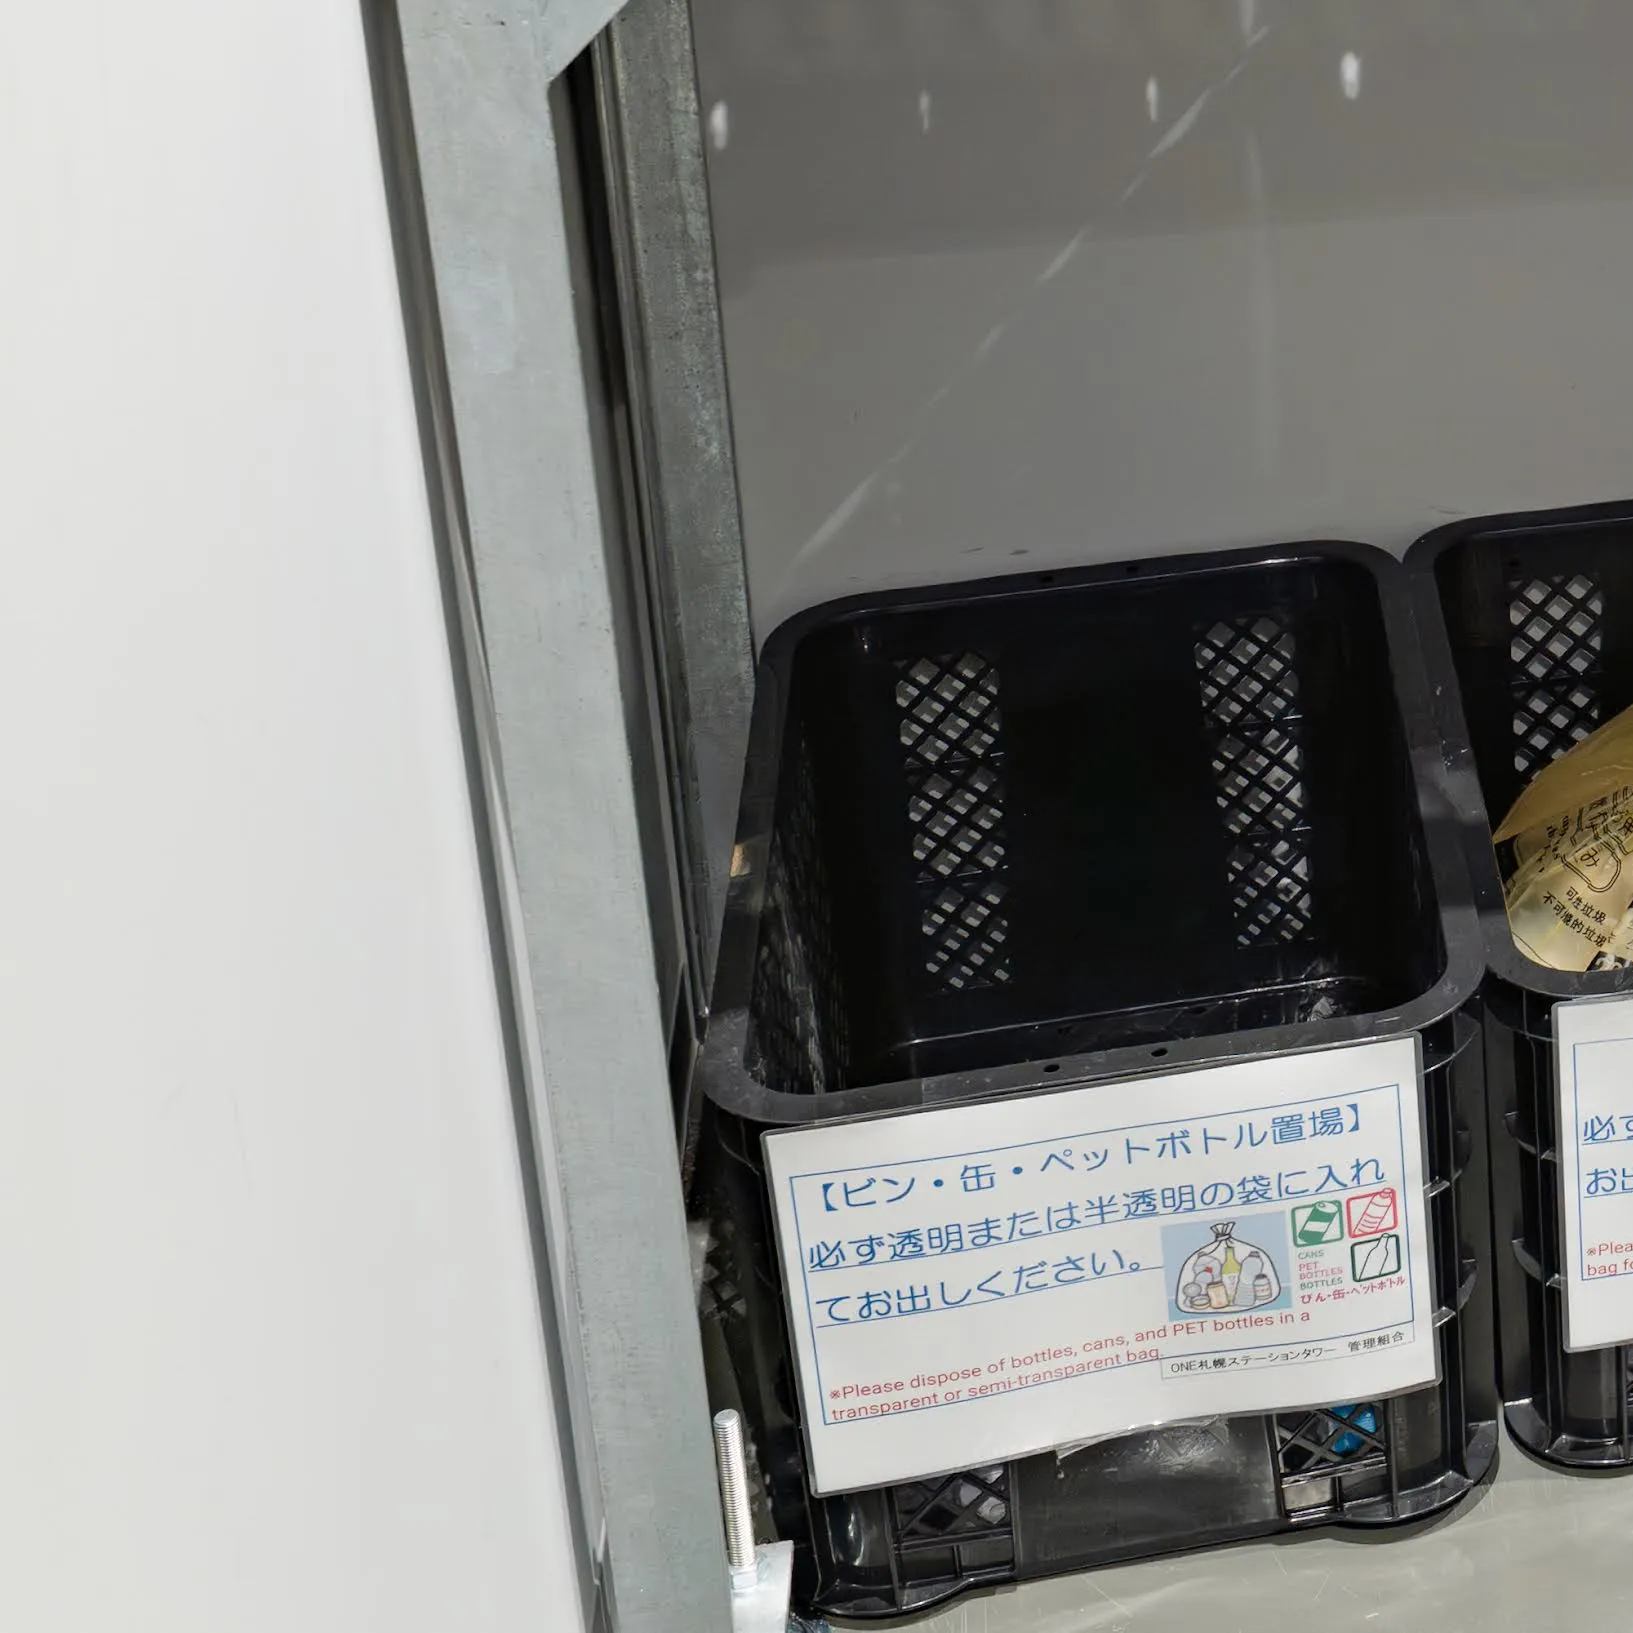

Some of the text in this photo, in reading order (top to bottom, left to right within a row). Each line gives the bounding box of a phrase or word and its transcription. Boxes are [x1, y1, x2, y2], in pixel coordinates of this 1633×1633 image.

[821, 1103, 1358, 1211] 【ビン・缶・ペットボトル置場】
[808, 1158, 1385, 1268] 必ず透明または半透明の袋に入れ
[817, 1246, 1142, 1323] てお出しください。
[1587, 1262, 1618, 1277] bag
[1171, 1331, 1404, 1373] ONE札幌ステーションタワー 管理組合
